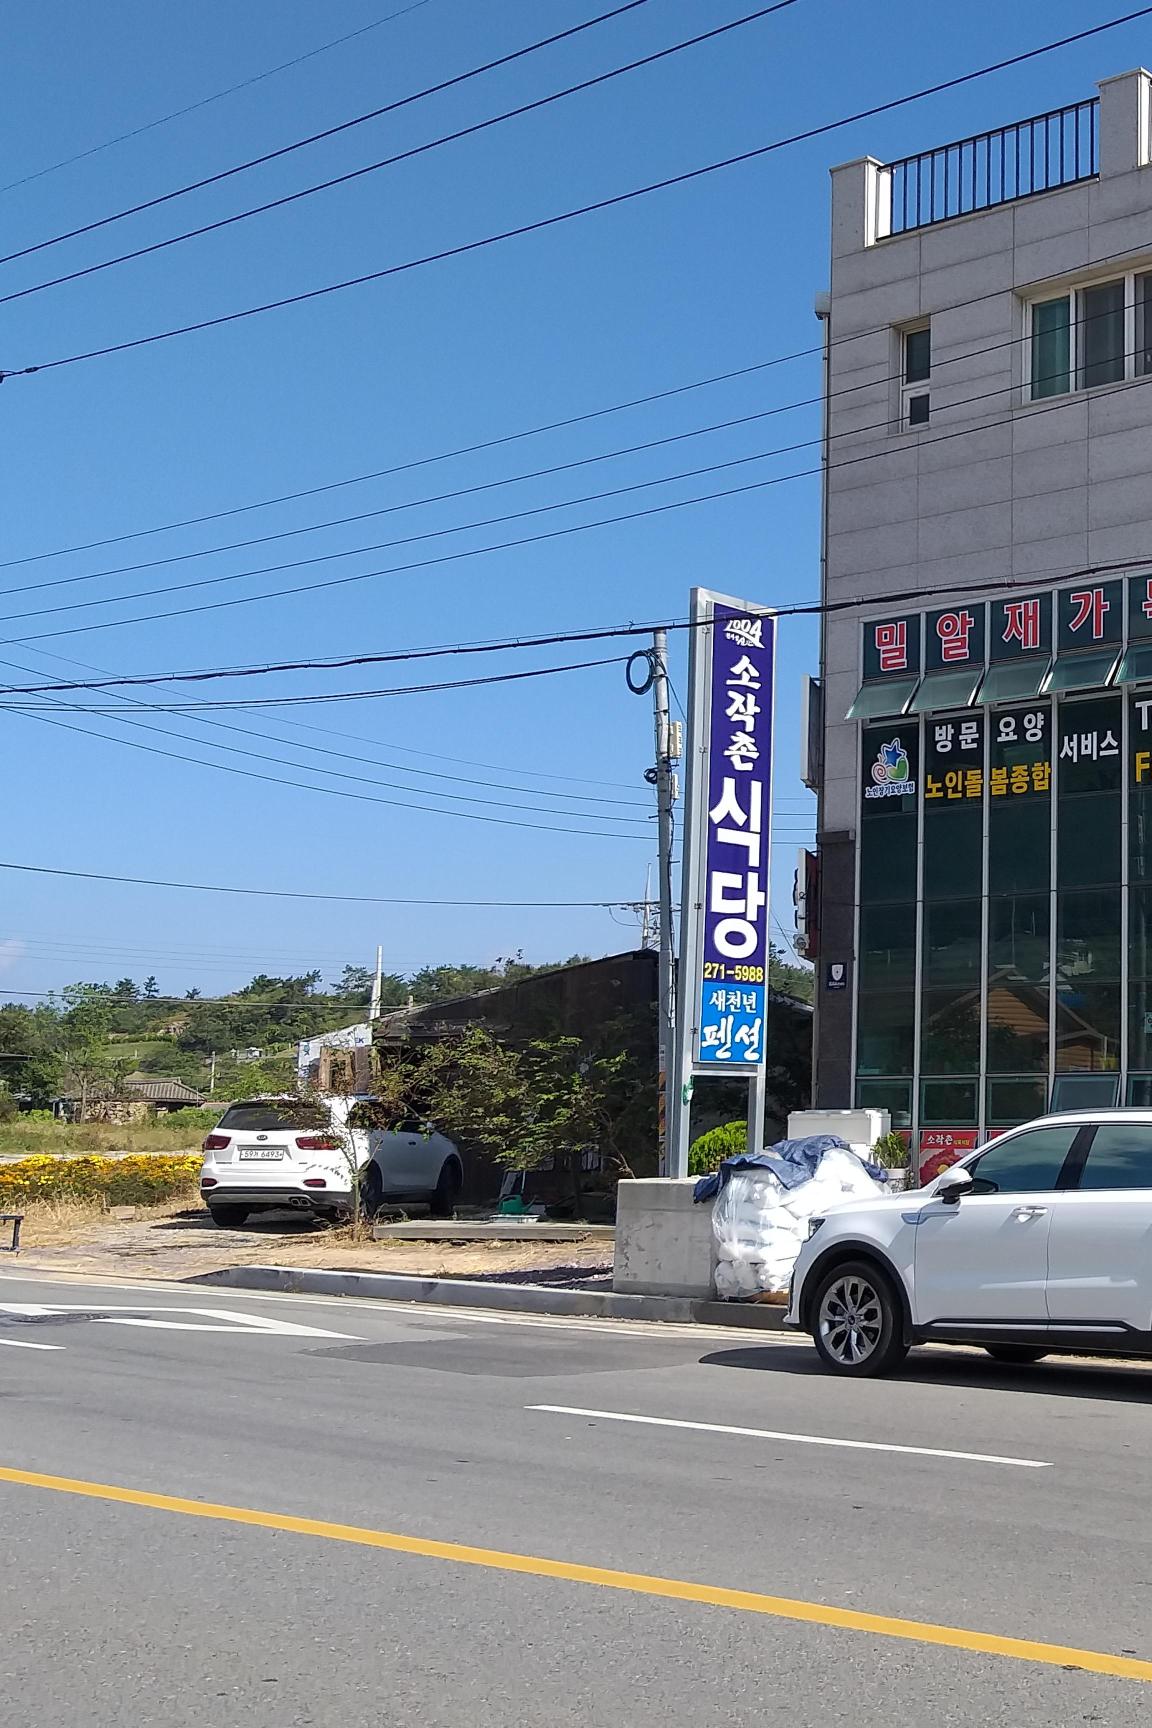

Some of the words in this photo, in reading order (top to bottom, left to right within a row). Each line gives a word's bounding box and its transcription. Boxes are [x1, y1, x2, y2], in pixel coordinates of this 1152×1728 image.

[724, 655, 762, 772] 소작촌
[1060, 729, 1120, 763] 서비스
[865, 782, 915, 798] 노인장기요양보험
[710, 776, 765, 959] 식당
[704, 962, 764, 982] 271-5988
[709, 989, 757, 1014] 새천년
[702, 1016, 761, 1061] 펜션
[927, 1134, 953, 1145] 소작촌
